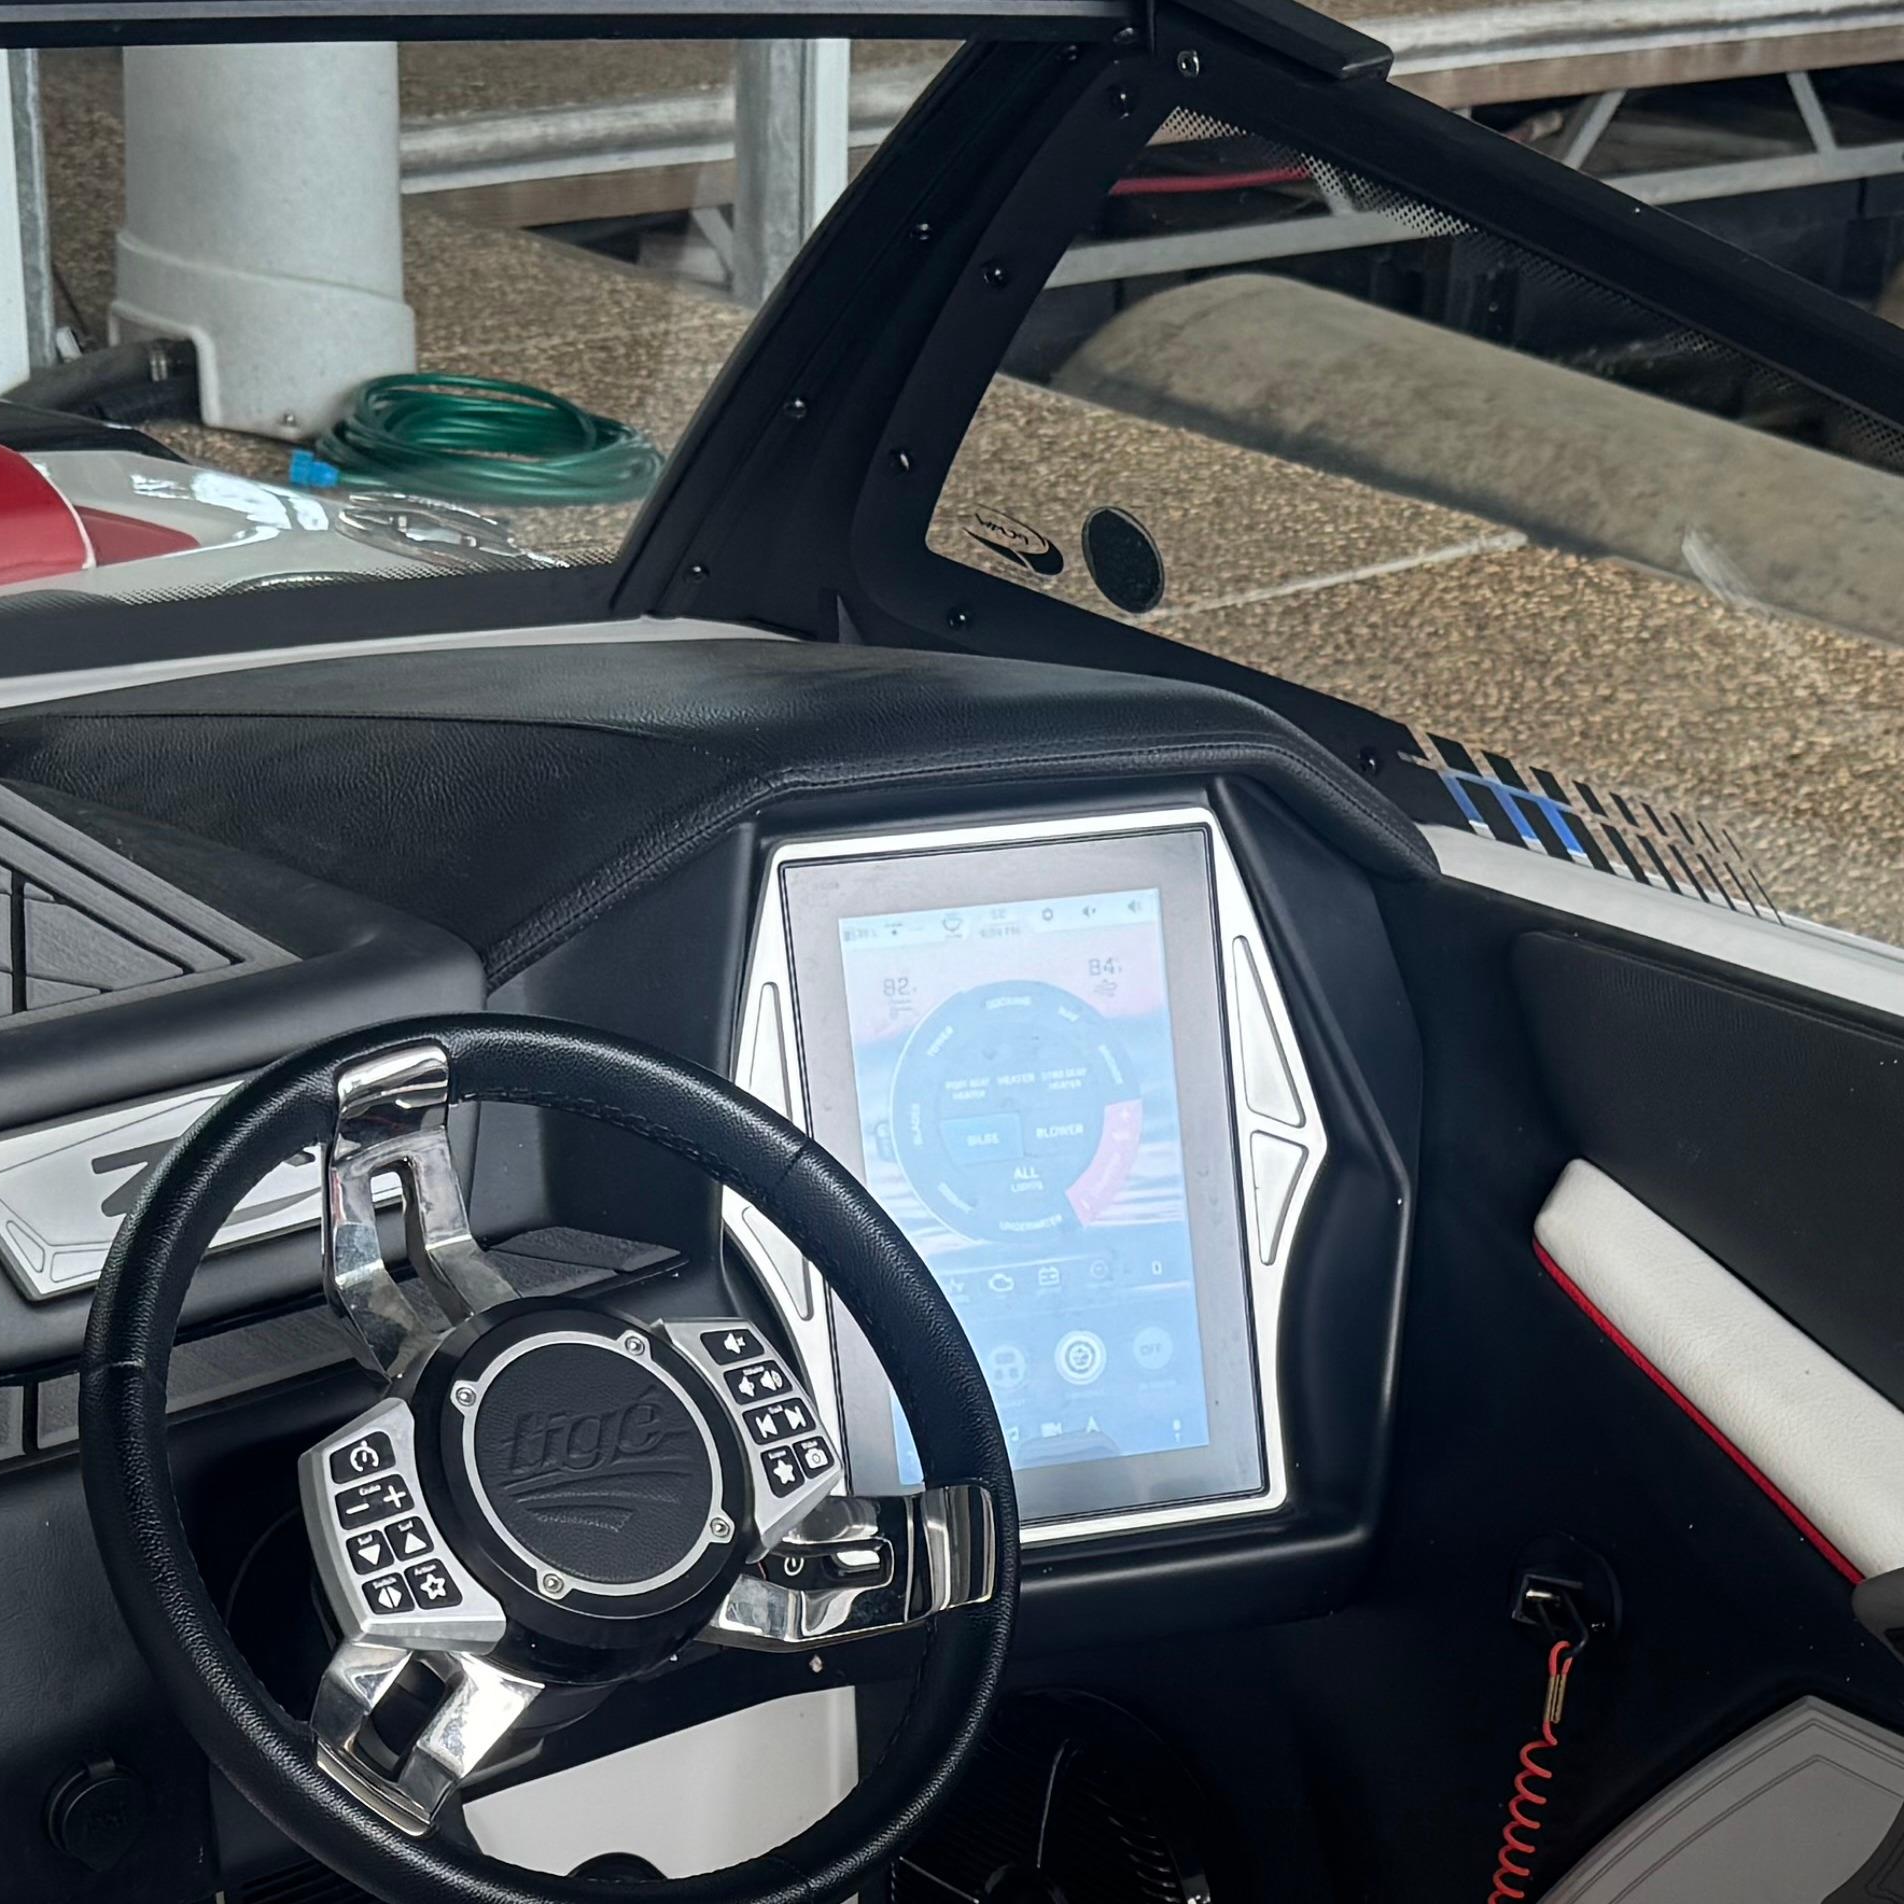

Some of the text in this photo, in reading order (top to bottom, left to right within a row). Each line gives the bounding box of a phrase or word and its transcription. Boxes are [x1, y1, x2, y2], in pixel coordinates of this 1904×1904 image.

[997, 1072, 1035, 1086] HEATER
[1036, 1123, 1084, 1139] BLOWER
[1013, 1166, 1039, 1180] ALL
